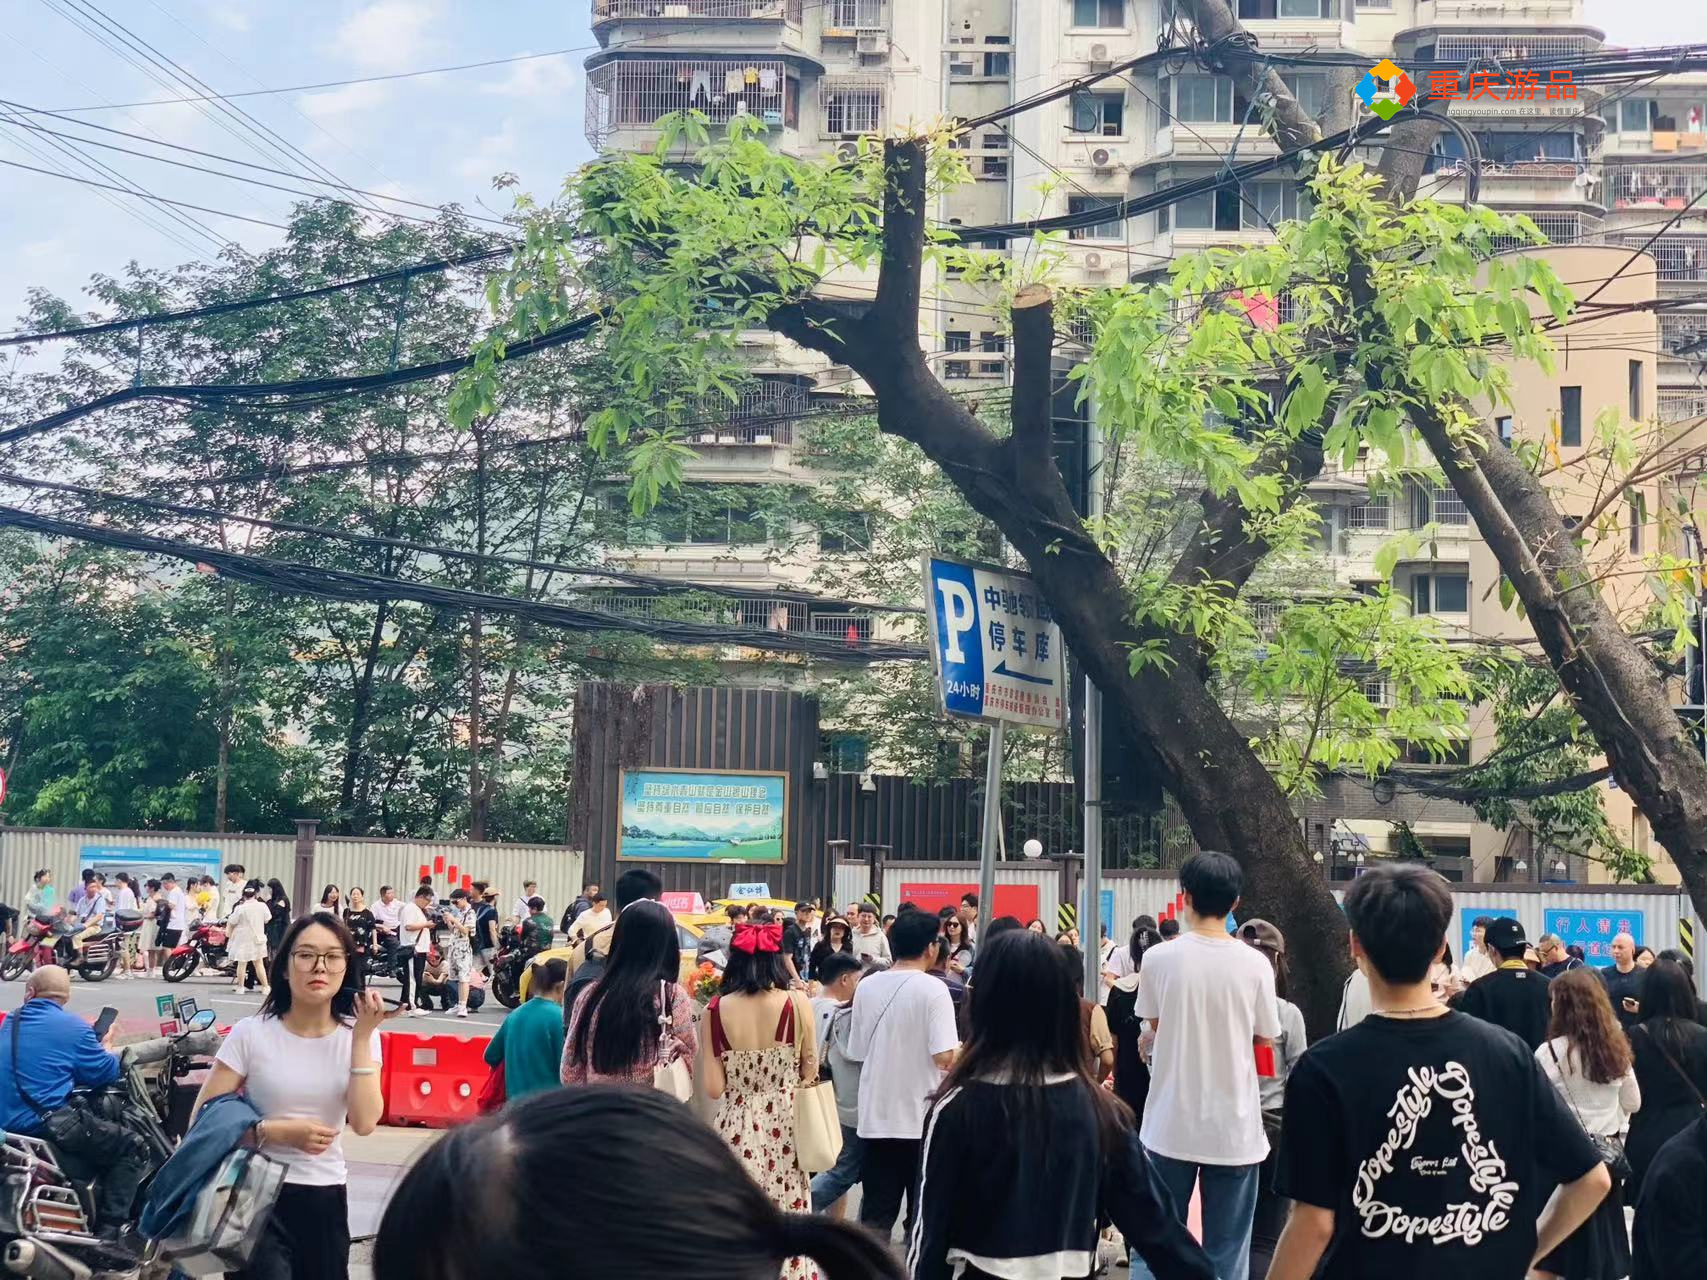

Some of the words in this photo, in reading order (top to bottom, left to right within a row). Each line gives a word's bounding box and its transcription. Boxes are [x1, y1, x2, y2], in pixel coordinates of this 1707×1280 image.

[937, 577, 975, 664] P
[989, 620, 1050, 663] 停车库
[946, 679, 980, 700] 24小时
[735, 803, 770, 816] 保护自然
[1556, 916, 1632, 935] 行人请走
